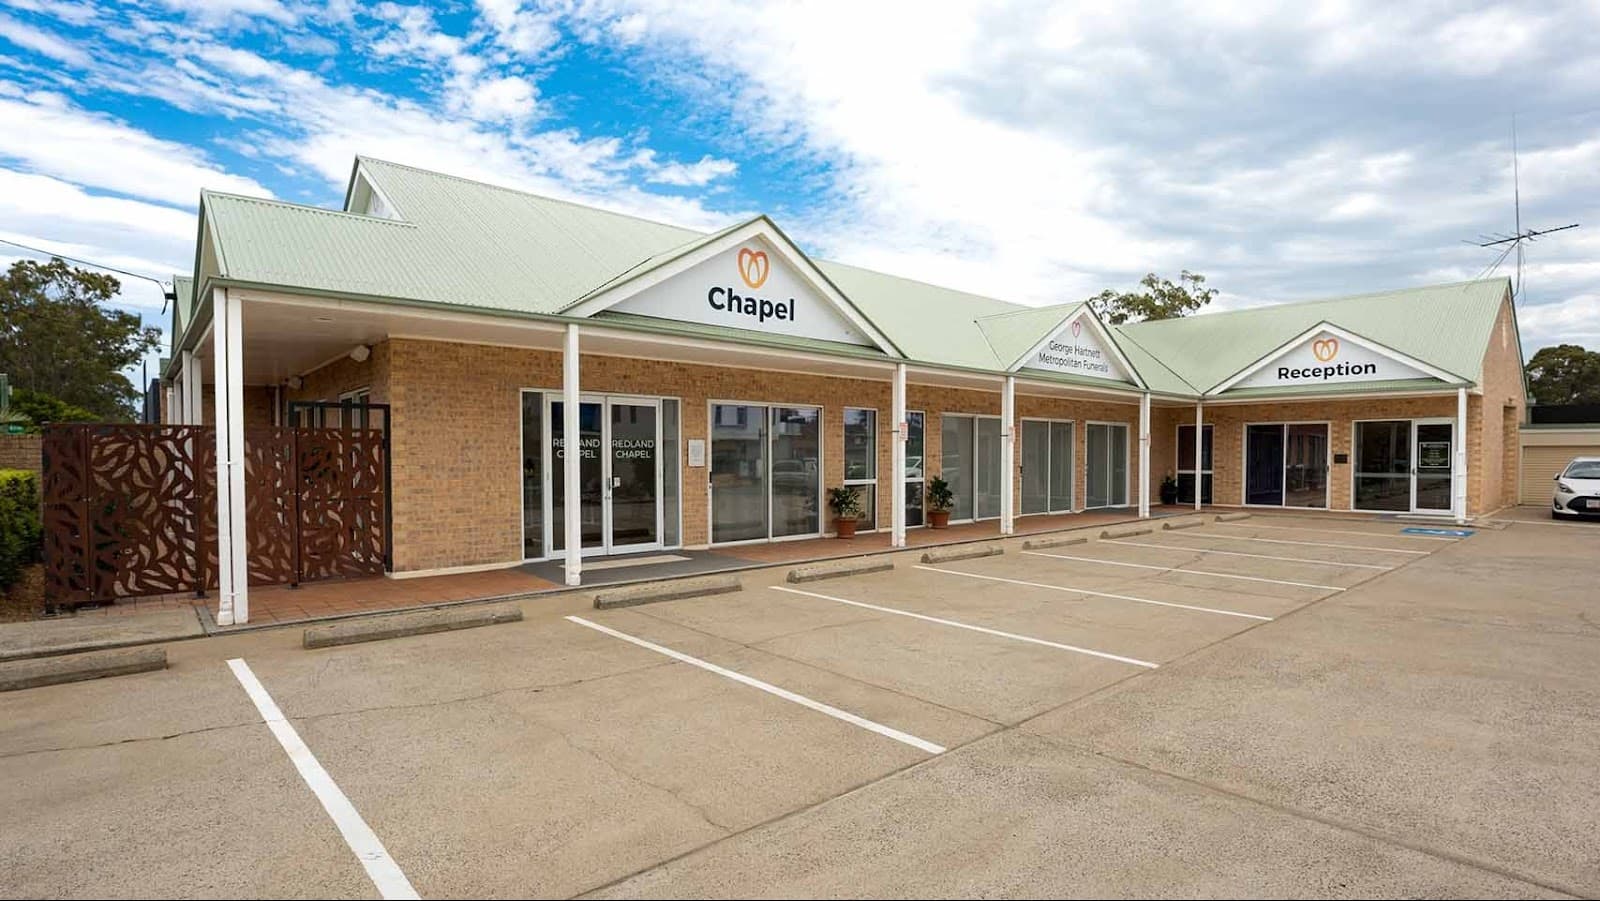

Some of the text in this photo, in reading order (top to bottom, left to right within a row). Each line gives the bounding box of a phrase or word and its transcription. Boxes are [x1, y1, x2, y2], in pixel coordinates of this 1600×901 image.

[708, 287, 795, 322] Chapel
[1049, 341, 1101, 359] George Hartnett
[1039, 353, 1108, 373] Metropolitan Funerals
[1278, 362, 1376, 379] Reception
[552, 439, 600, 448] REAND
[612, 439, 654, 448] REDLAND
[556, 449, 597, 458] CPEL
[616, 450, 651, 458] CHAPEL
